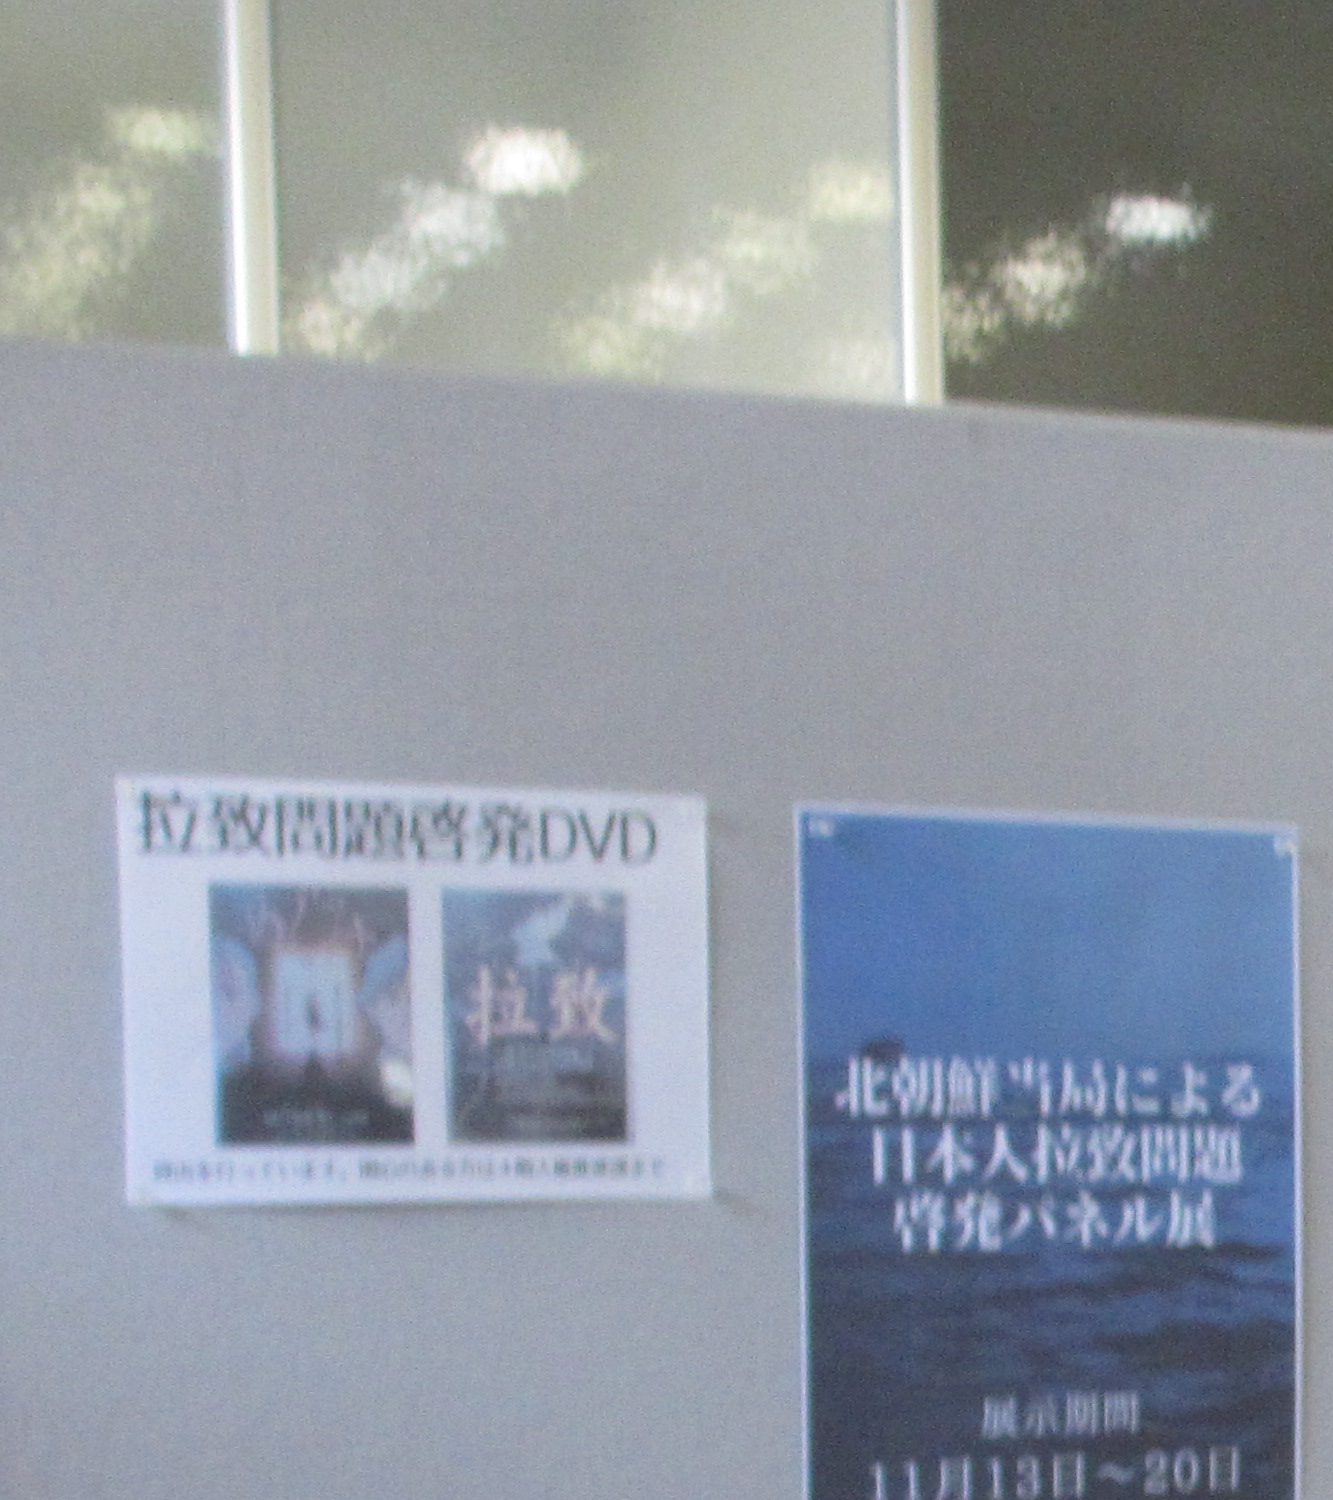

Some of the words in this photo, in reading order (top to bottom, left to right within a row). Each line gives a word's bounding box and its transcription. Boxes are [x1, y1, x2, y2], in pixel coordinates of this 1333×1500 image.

[138, 790, 658, 867] 拉致問題啓発DVD
[466, 963, 617, 1046] 拉致
[835, 1055, 1262, 1118] 北朝鮮当局による
[870, 1124, 1243, 1186] 日本人拉致問題
[893, 1190, 1217, 1254] 啓発パネル展
[982, 1391, 1141, 1440] 展示期間
